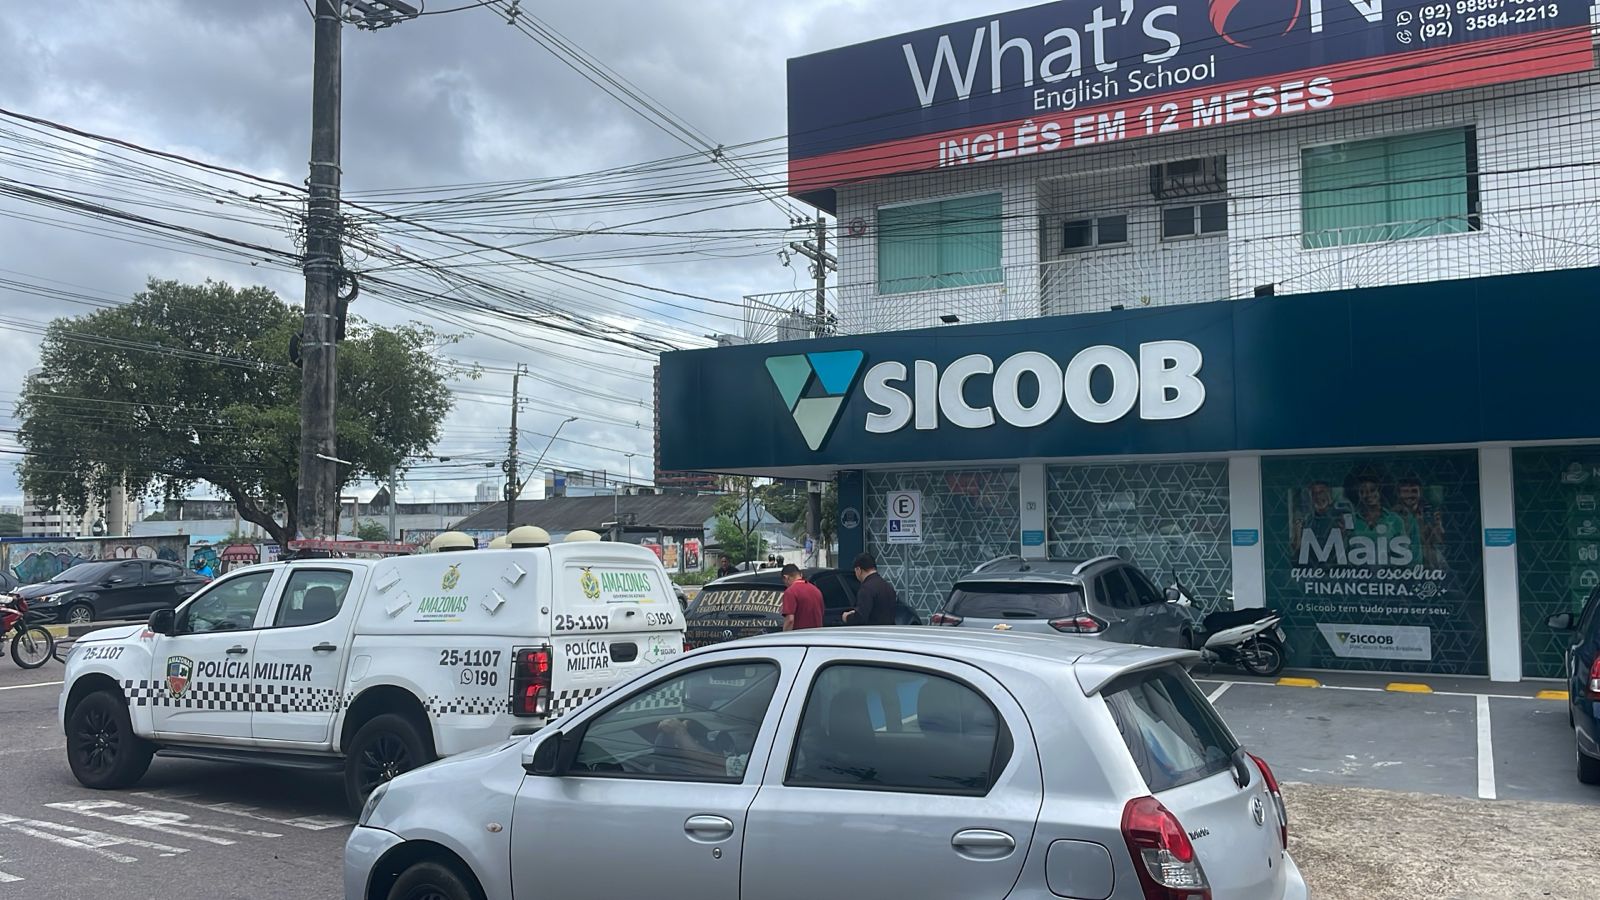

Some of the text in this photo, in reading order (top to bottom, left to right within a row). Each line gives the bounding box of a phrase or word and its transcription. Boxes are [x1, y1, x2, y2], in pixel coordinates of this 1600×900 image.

[1418, 3, 1451, 24] (92)
[1419, 4, 1559, 42] (92) 3584-2213
[902, 0, 1181, 108] What's
[1034, 54, 1216, 111] English School
[939, 77, 1334, 168] INGLÊS EM 12 MESES
[863, 339, 1206, 434] SICOOB
[898, 499, 909, 514] E
[1298, 524, 1414, 566] Mais
[601, 572, 651, 592] AMAZONAS
[1291, 564, 1447, 582] que uma escolha
[1304, 581, 1414, 596] FINANCEIRA.
[417, 596, 469, 613] AMAZONAS
[699, 590, 785, 607] FORTE REAL
[1296, 603, 1450, 615] O Sicoob tem tudo para ser seu.
[555, 612, 673, 631] 25-1107 190
[730, 619, 778, 627] DISTÂNCIA
[565, 639, 608, 656] POLÍCIA
[1350, 634, 1394, 645] SICOOB
[83, 646, 125, 660] 25-1107
[439, 649, 501, 667] 25-1107
[196, 657, 313, 682] POLÍCIA MILITAR
[567, 656, 609, 672] MILITAR
[474, 670, 498, 687] 190
